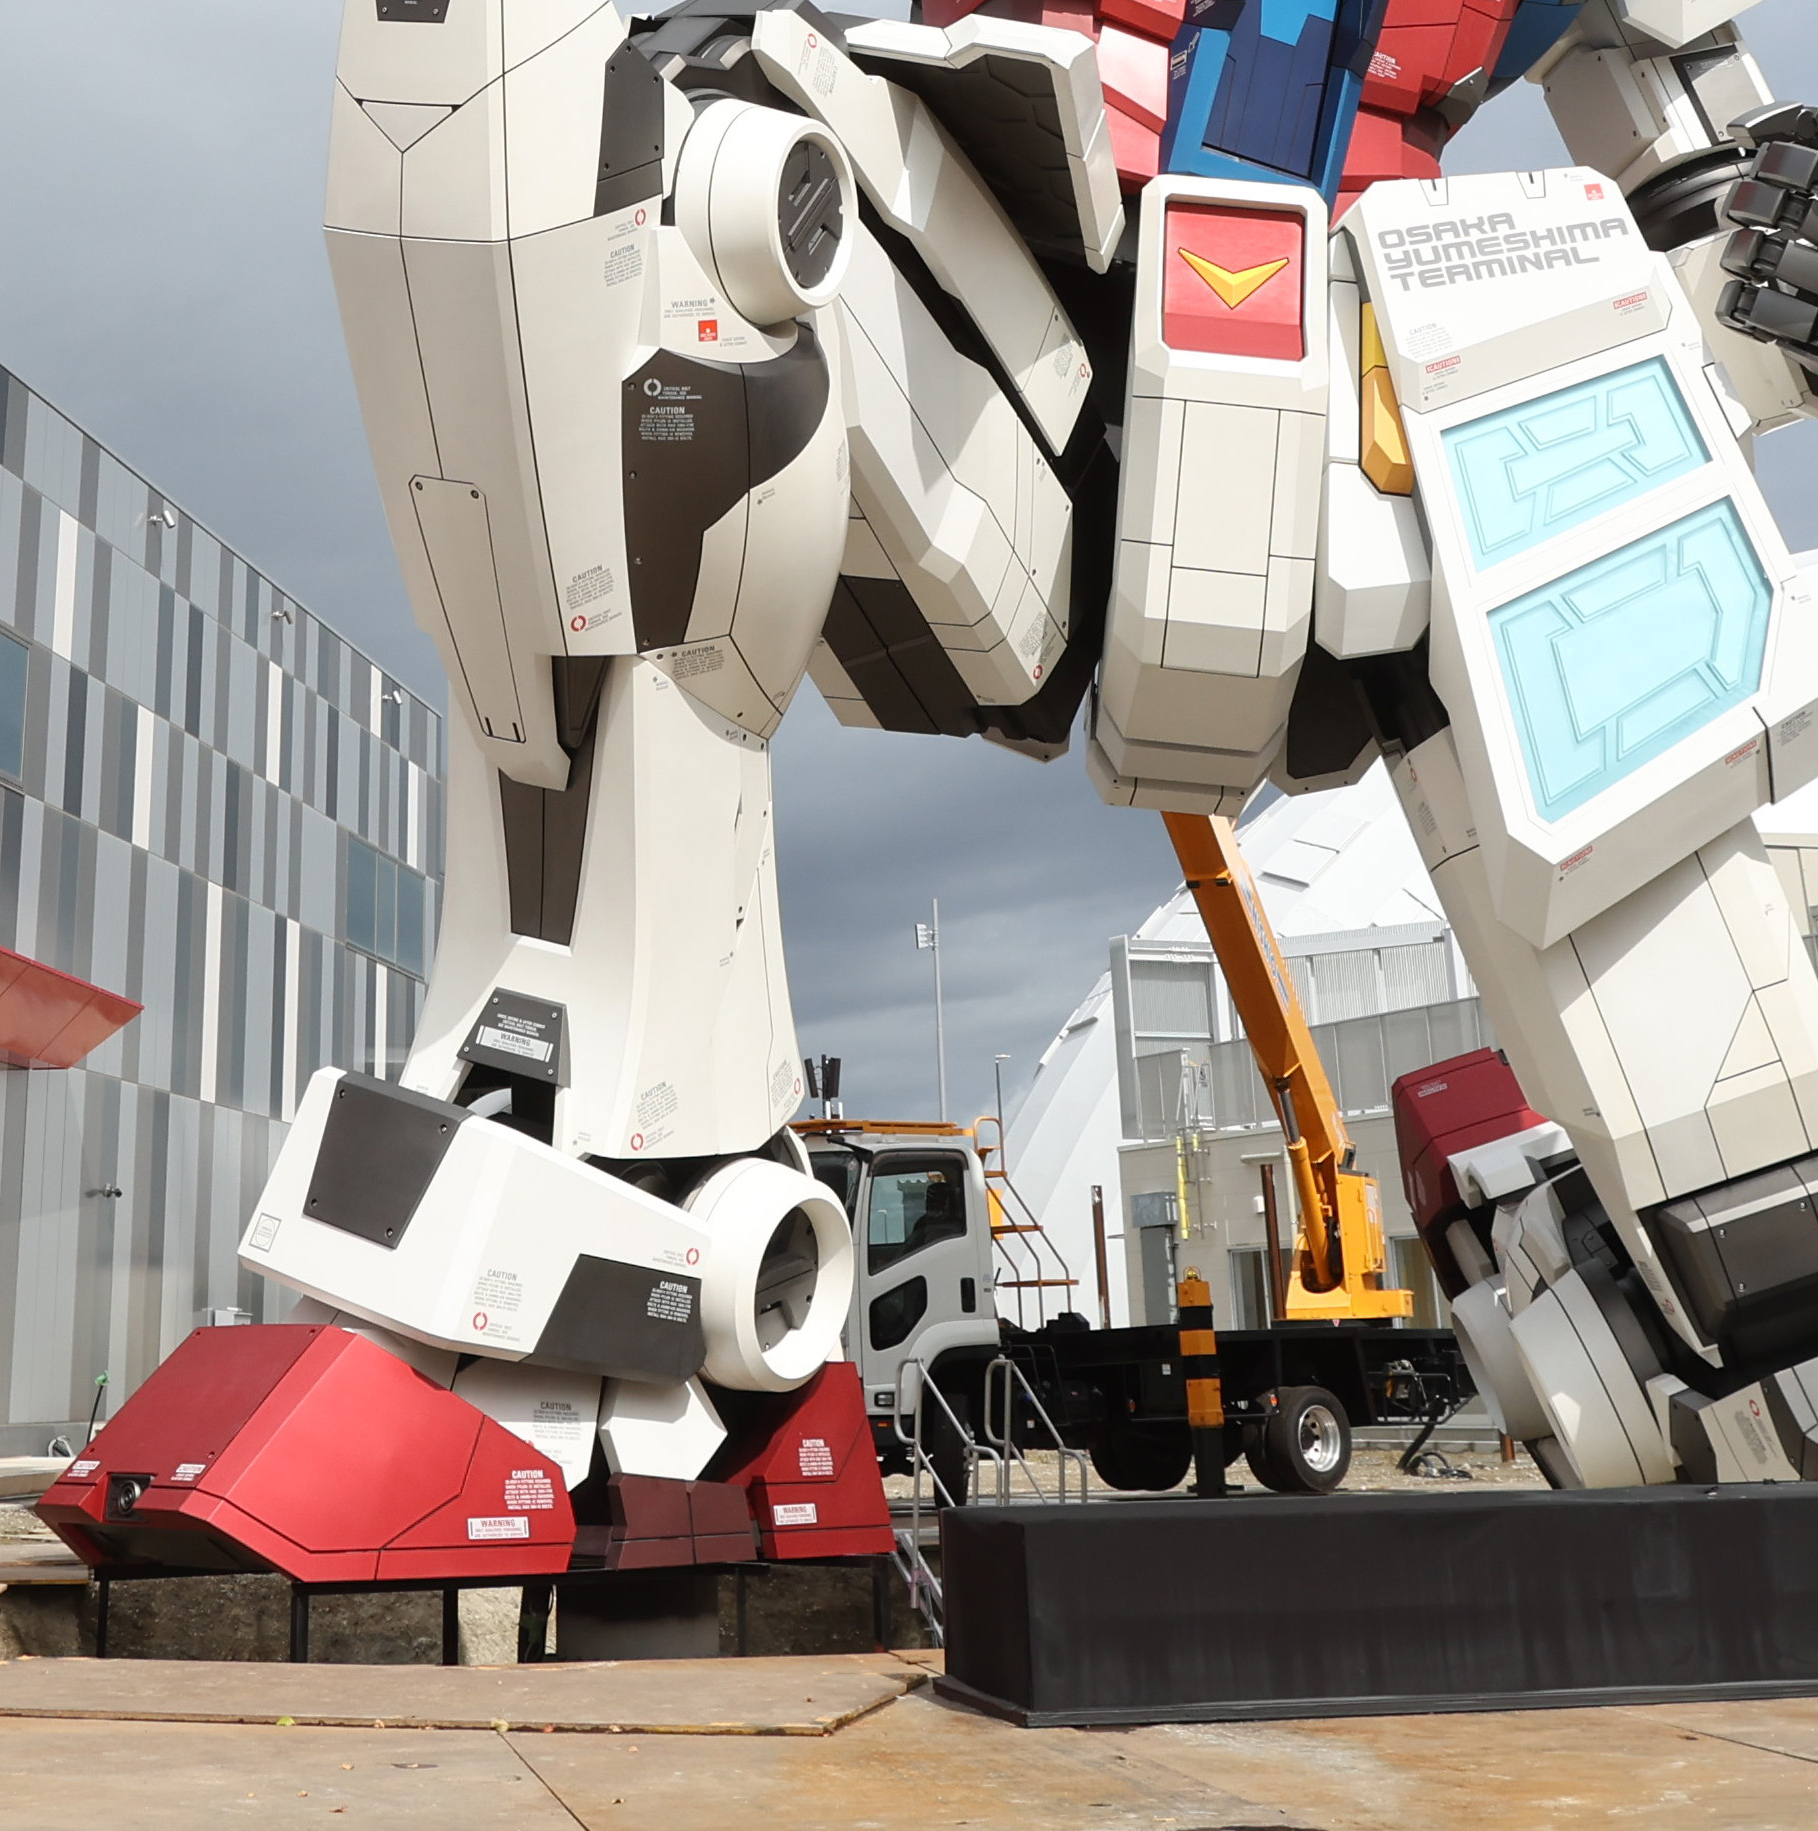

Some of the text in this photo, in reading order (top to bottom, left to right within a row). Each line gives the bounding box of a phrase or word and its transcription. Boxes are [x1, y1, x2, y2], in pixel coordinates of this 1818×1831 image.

[1378, 212, 1516, 250] OSAKA
[1383, 217, 1629, 271] YUMESHIMA
[1390, 246, 1601, 291] TERMINAL
[671, 299, 708, 308] WARNING
[649, 406, 685, 415] CAUTION
[572, 564, 603, 583] CAUTION
[681, 645, 715, 657] CAUTION
[487, 1269, 517, 1281] CAUTION
[659, 1280, 689, 1293] CAUTION
[511, 1469, 544, 1479] CAUTION
[480, 1519, 516, 1528] WARNING
